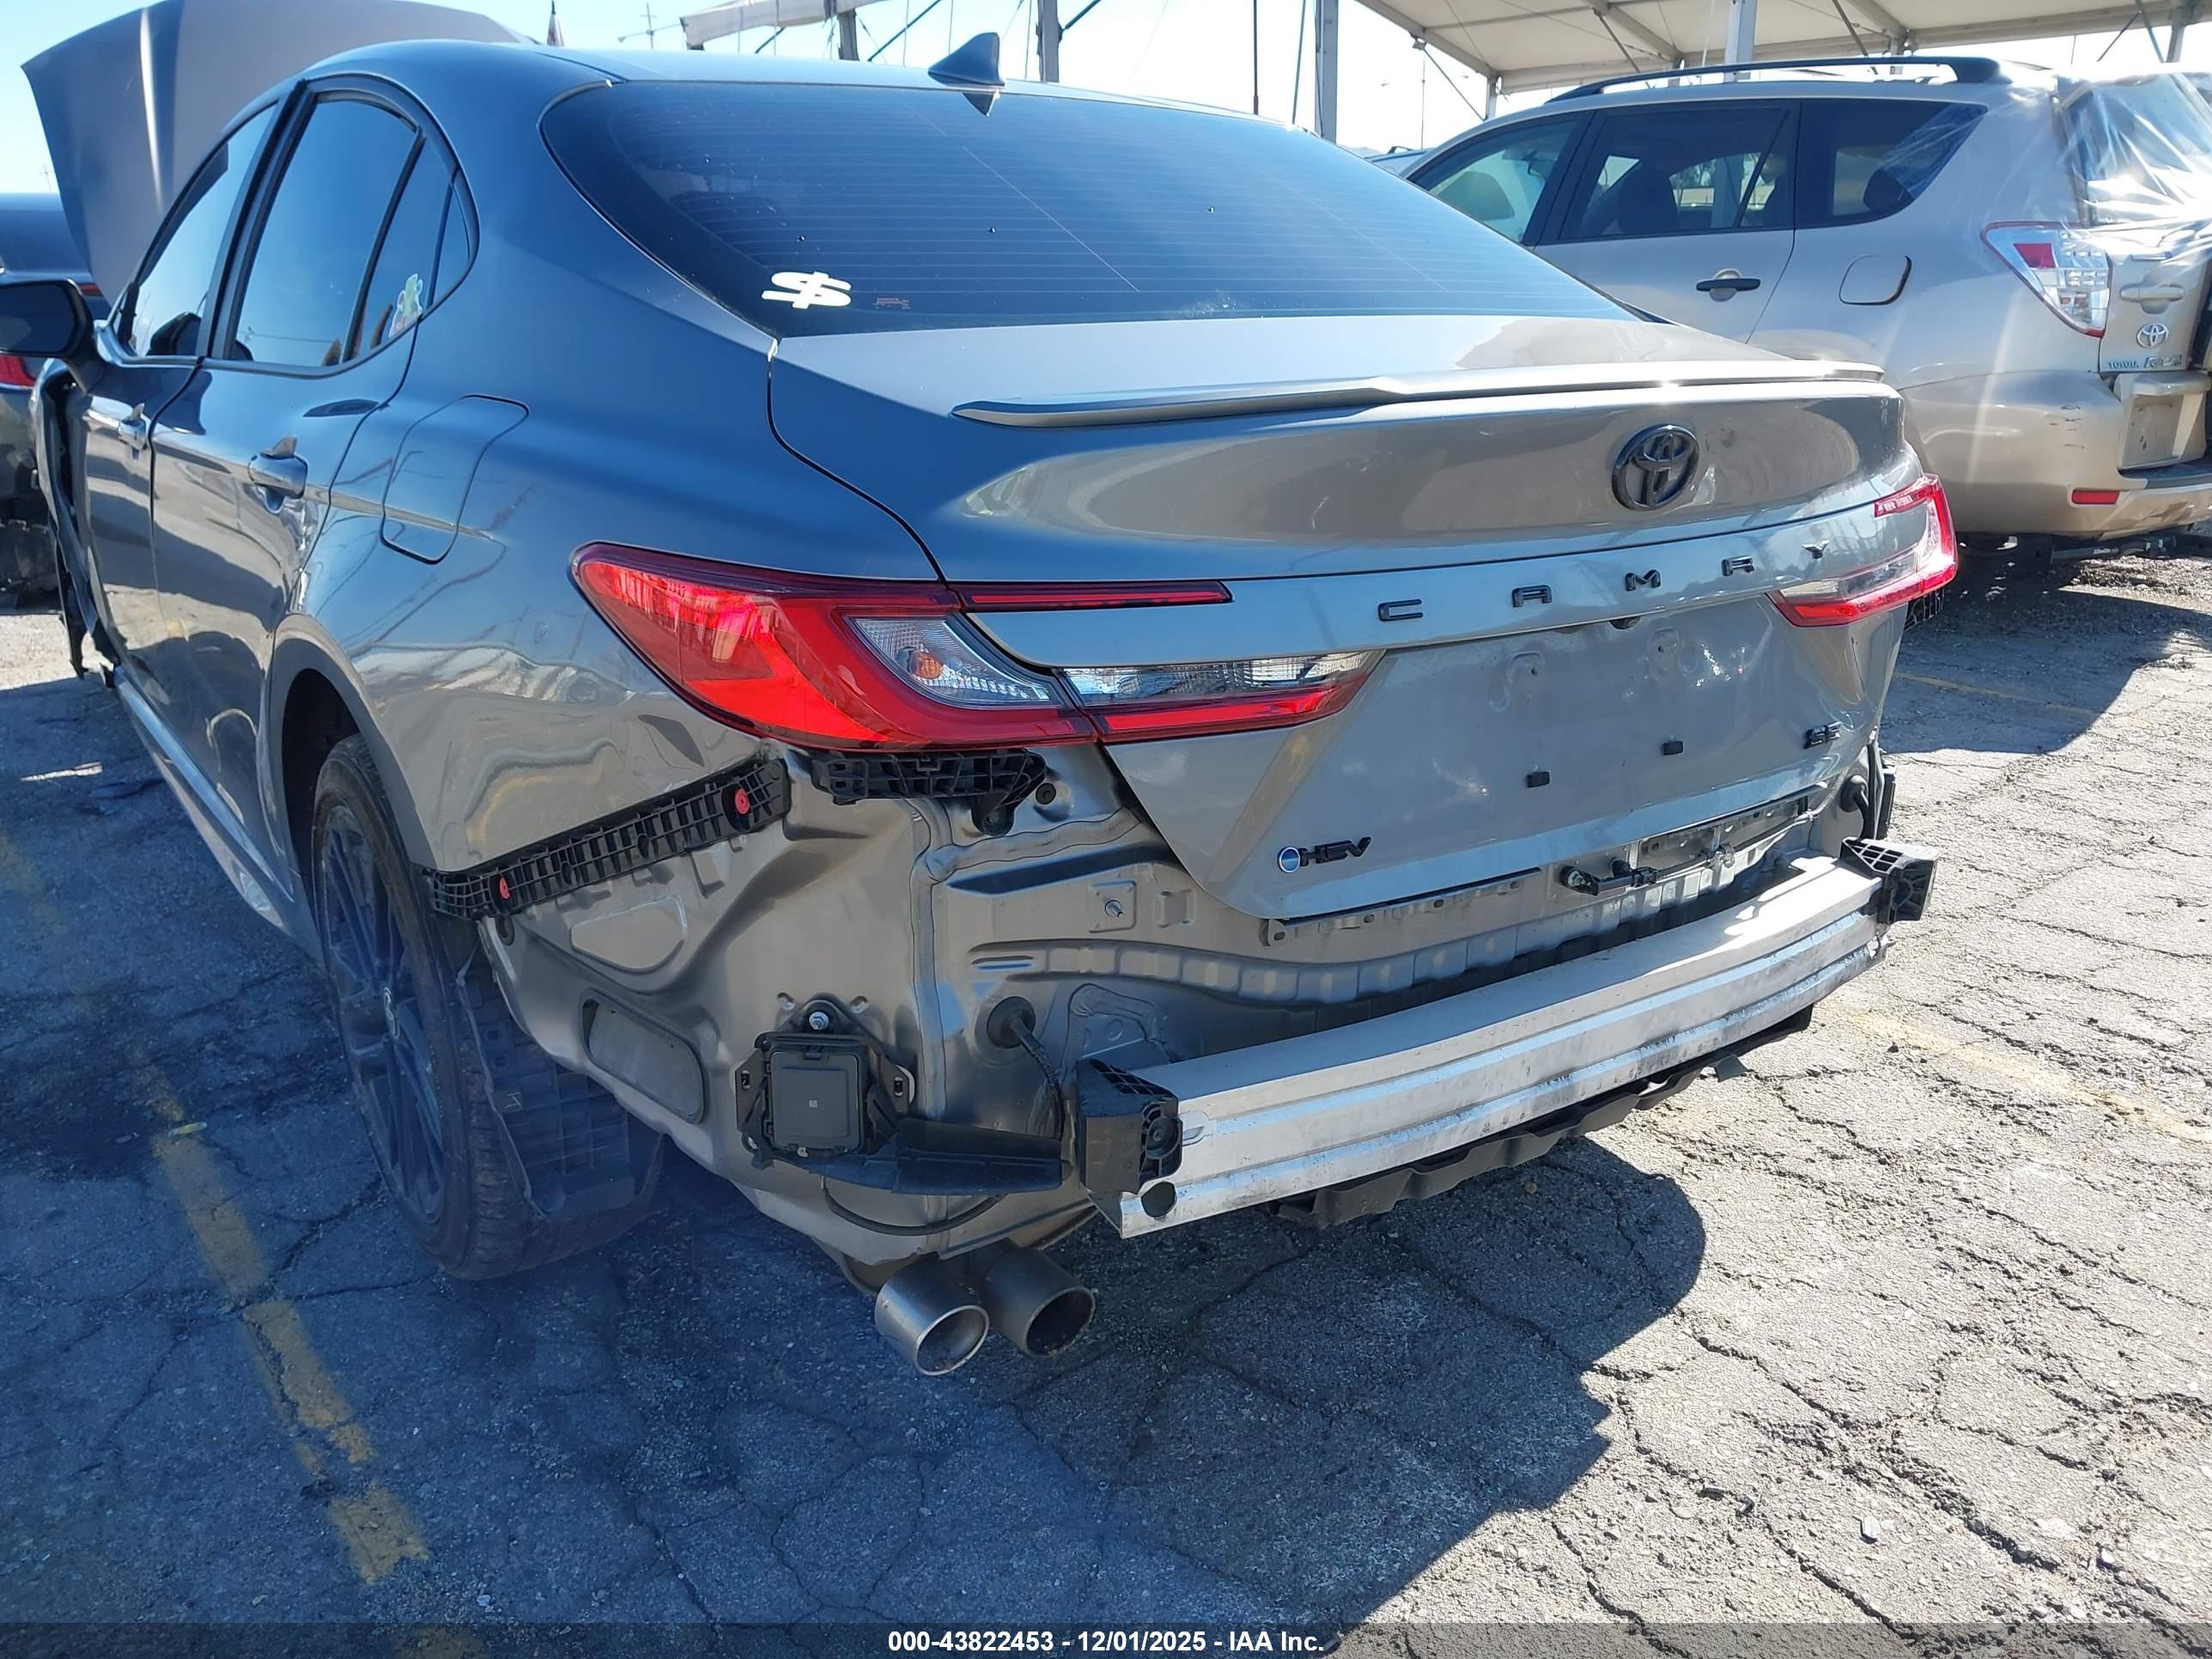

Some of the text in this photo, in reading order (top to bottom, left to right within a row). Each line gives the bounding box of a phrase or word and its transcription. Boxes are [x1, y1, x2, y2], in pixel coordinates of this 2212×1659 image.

[1376, 538, 1830, 623] CAMRY
[1803, 721, 1841, 749] SE
[1297, 836, 1370, 866] HEV
